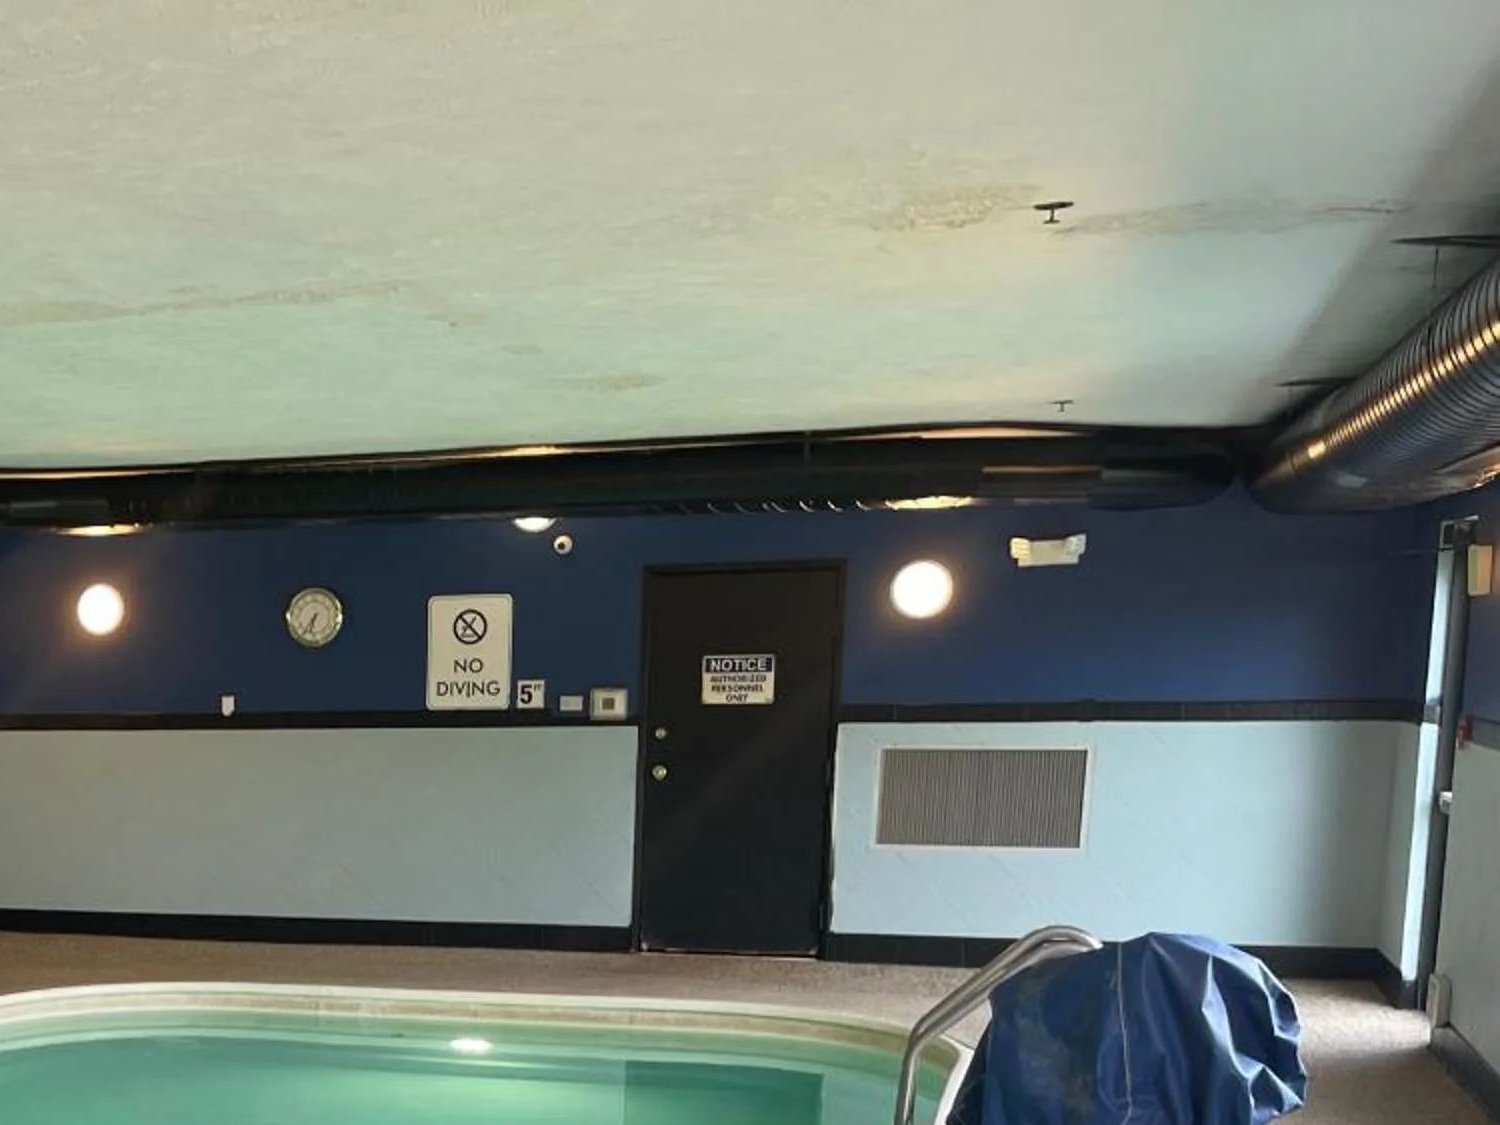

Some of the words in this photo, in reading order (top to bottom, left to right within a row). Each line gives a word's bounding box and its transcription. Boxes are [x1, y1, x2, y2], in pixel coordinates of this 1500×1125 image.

[453, 658, 484, 673] NO
[711, 659, 767, 671] NOTICE
[436, 681, 501, 698] DIVING
[520, 684, 533, 705] 5
